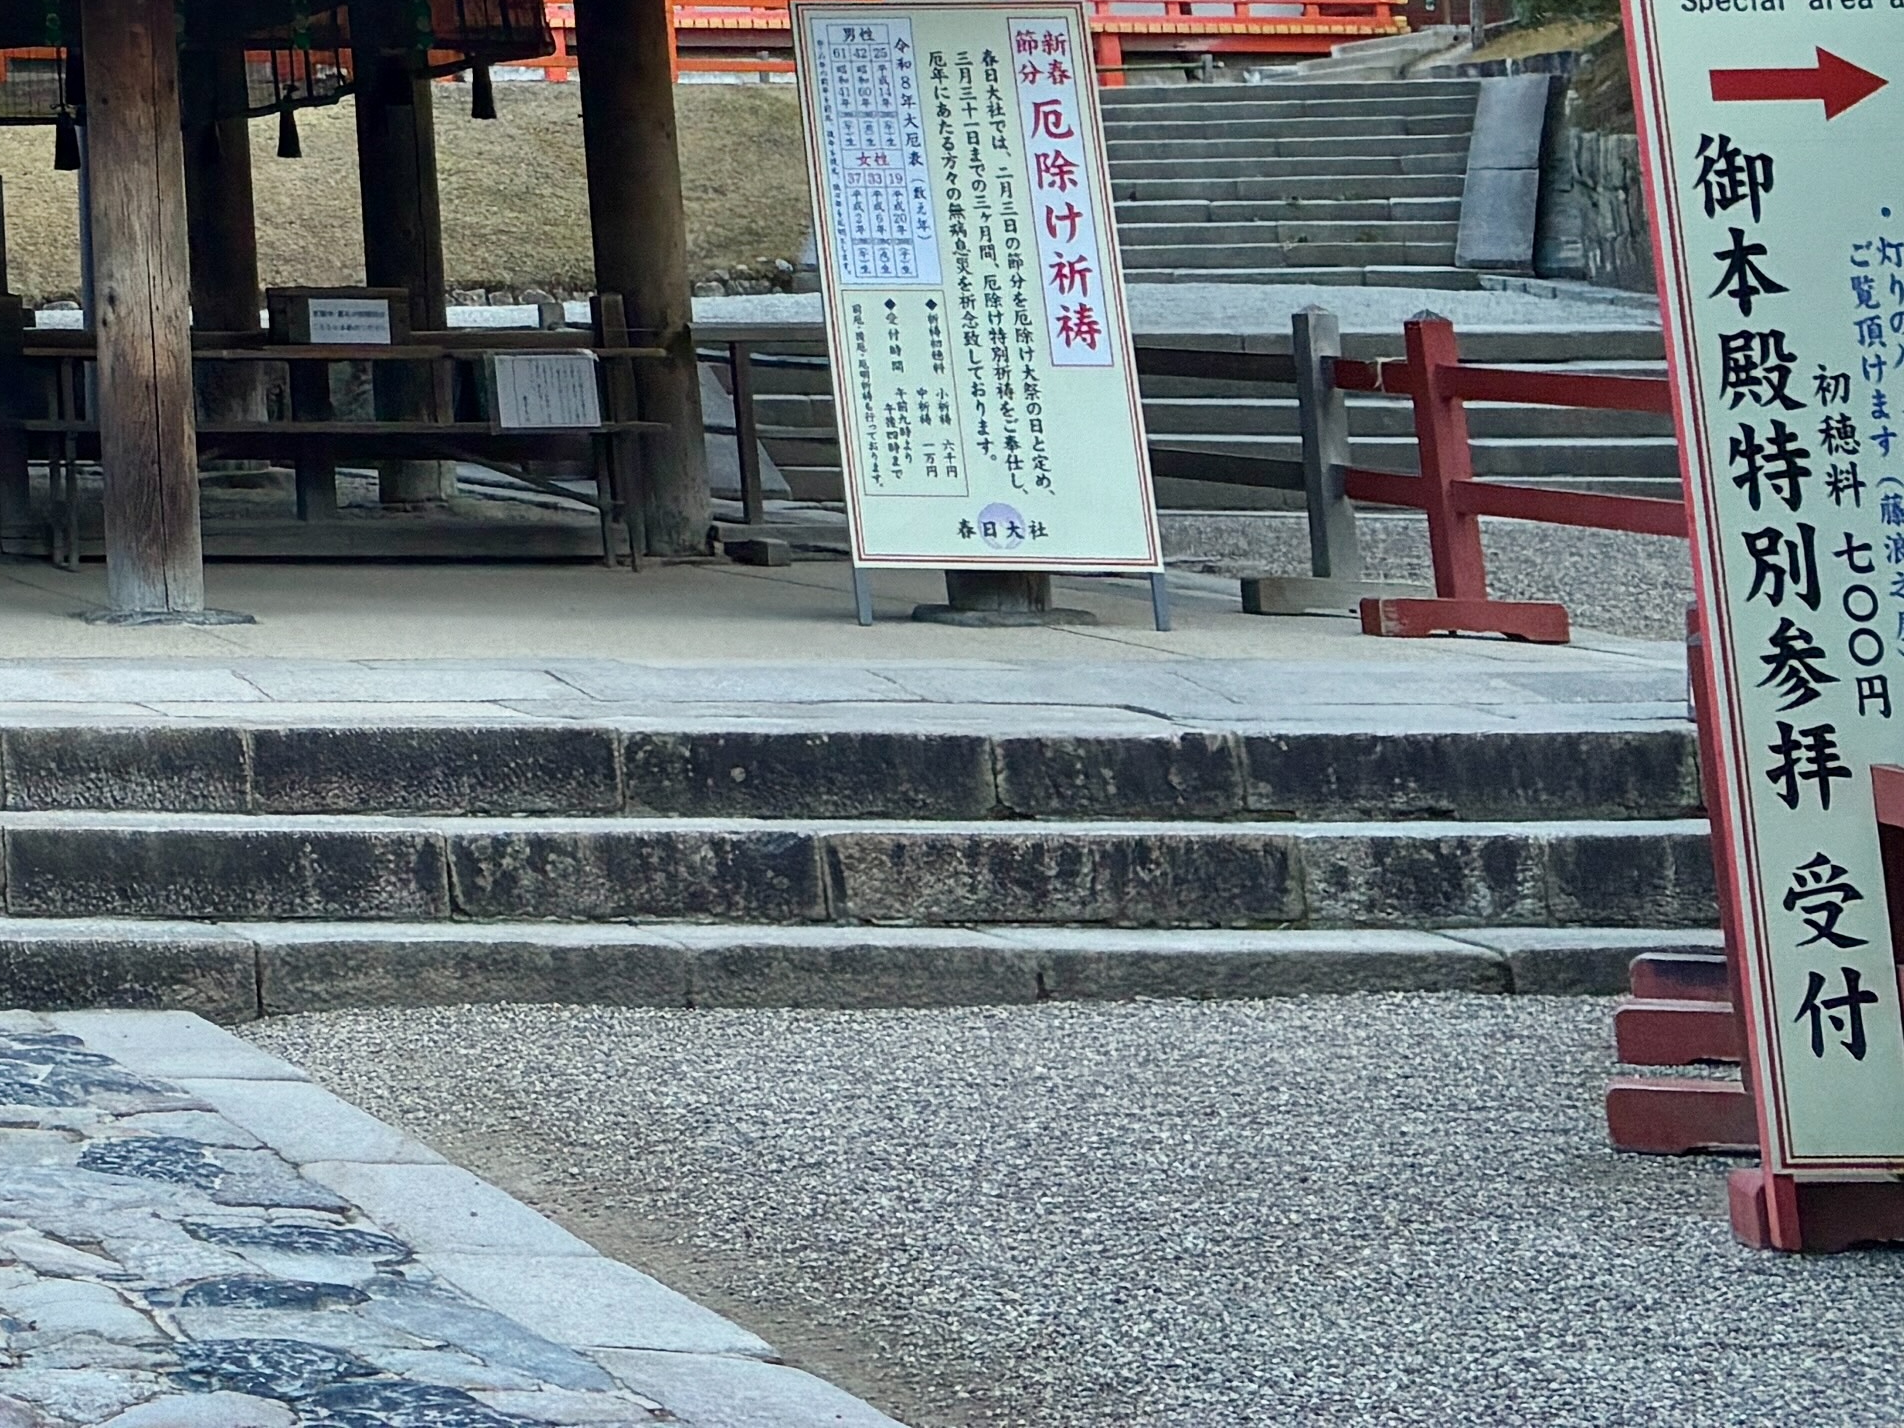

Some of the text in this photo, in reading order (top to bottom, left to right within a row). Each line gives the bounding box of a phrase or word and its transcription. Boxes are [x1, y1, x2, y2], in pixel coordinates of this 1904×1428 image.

[833, 47, 888, 59] 61 42 25
[843, 27, 875, 42] 男性
[1016, 30, 1045, 85] 節分
[1041, 30, 1072, 86] 新春
[847, 172, 903, 185] 37 33 19
[856, 151, 890, 167] 女性
[1031, 98, 1102, 351] 厄除け祈祷
[885, 312, 913, 464] 受付時間 午前九時より
[884, 403, 904, 480] 午後四時まで
[942, 439, 958, 479] 六千円
[1813, 363, 1867, 509] 初穂料
[922, 443, 938, 478] 一万円
[957, 518, 1050, 540] 春日大社
[1692, 132, 1879, 1061] 御本殿特別参拝 受付
